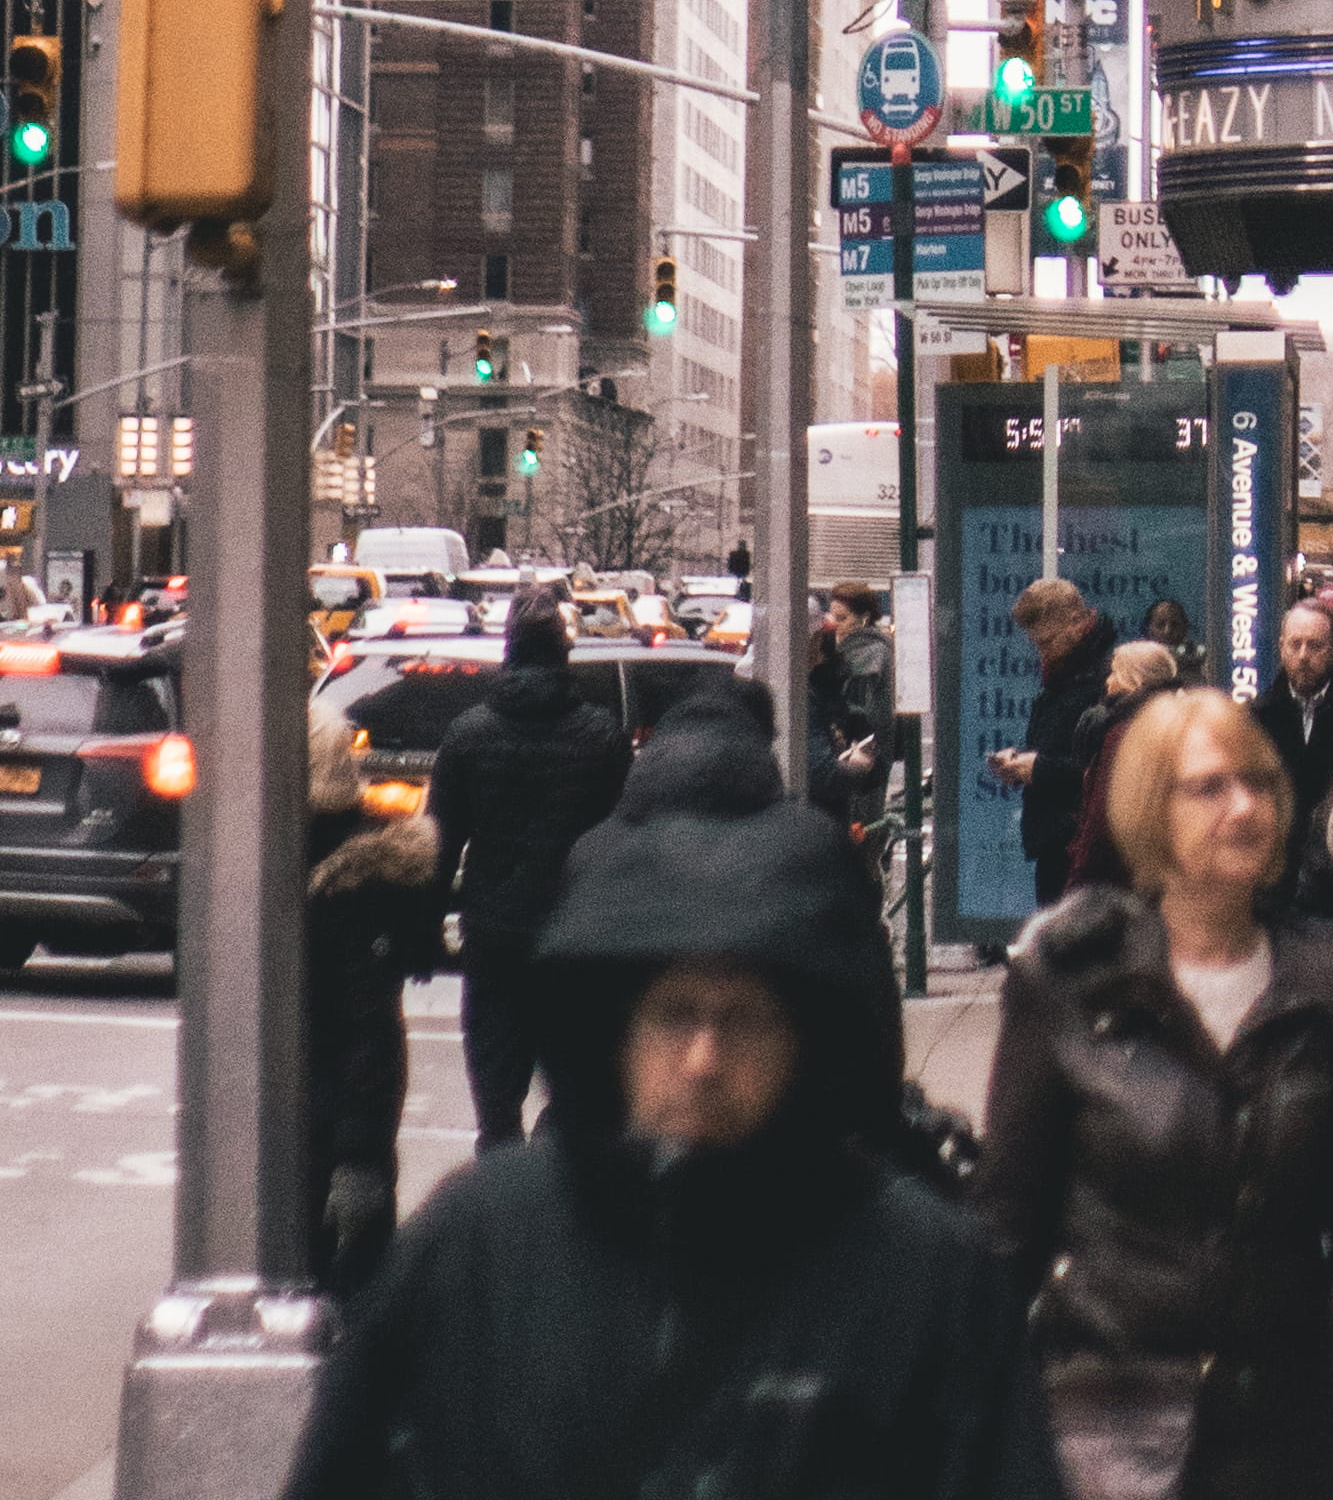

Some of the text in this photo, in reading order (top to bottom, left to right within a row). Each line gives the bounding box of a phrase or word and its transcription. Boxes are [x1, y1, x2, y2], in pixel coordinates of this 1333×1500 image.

[1020, 94, 1055, 132] 50
[1060, 94, 1085, 114] ST
[840, 173, 871, 200] M5
[843, 208, 872, 235] M5
[1121, 231, 1172, 248] ONLY
[842, 244, 871, 271] M7
[1176, 416, 1208, 449] 37
[1232, 411, 1257, 430] 6
[1231, 437, 1257, 548] Avenue
[1231, 554, 1258, 578] &
[1231, 583, 1258, 661] West
